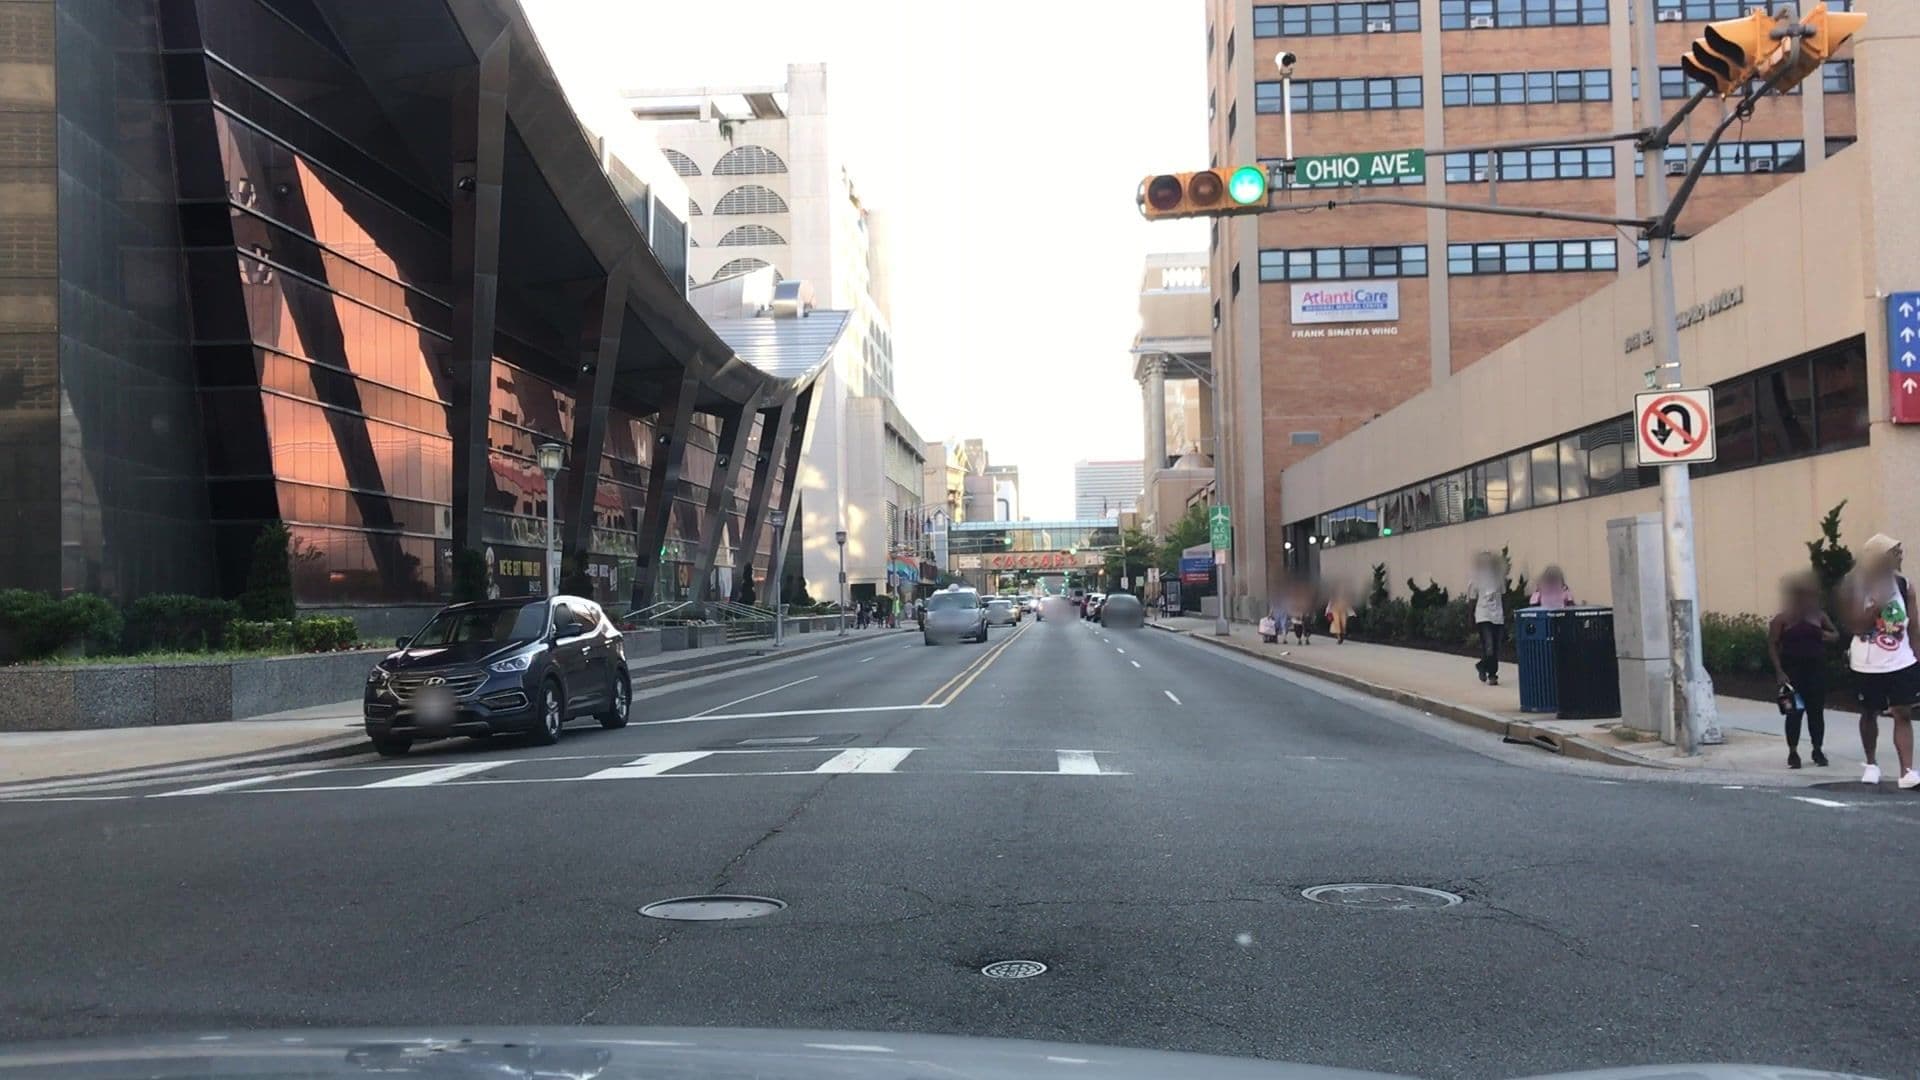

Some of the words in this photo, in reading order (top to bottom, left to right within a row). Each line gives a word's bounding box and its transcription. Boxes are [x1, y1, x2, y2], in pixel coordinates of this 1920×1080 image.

[1306, 156, 1360, 181] OHIO
[1370, 153, 1416, 177] AVE.
[1303, 288, 1388, 304] AtlantiCare
[1292, 329, 1325, 338] FRANK
[1327, 327, 1369, 337] SINATRA
[1371, 326, 1398, 335] WING
[992, 554, 1078, 568] CAESARS
